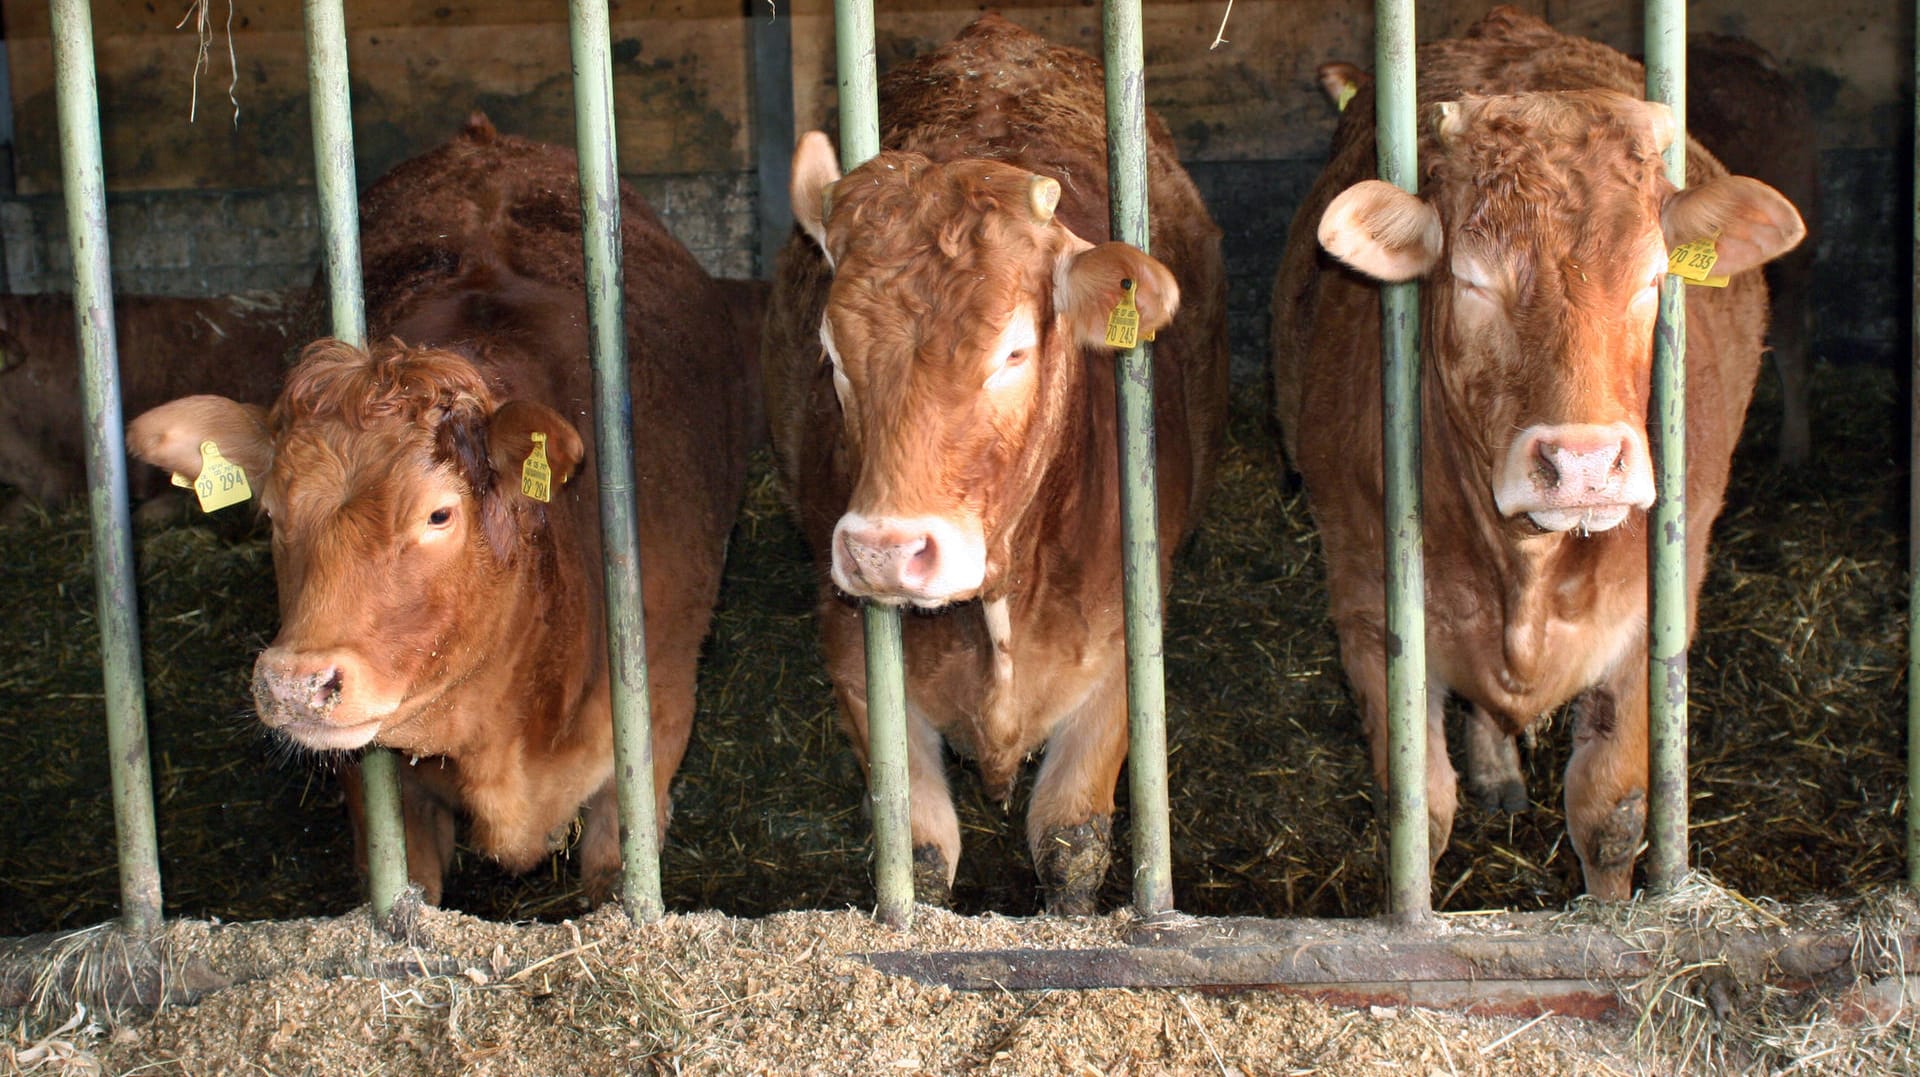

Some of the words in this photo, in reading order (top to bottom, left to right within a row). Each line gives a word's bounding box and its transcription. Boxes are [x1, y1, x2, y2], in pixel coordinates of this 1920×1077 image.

[1670, 247, 1689, 263] 70
[1688, 253, 1715, 270] 235
[1106, 324, 1118, 341] 70
[1119, 326, 1136, 345] 245
[198, 479, 213, 498] 29
[219, 470, 244, 491] 294
